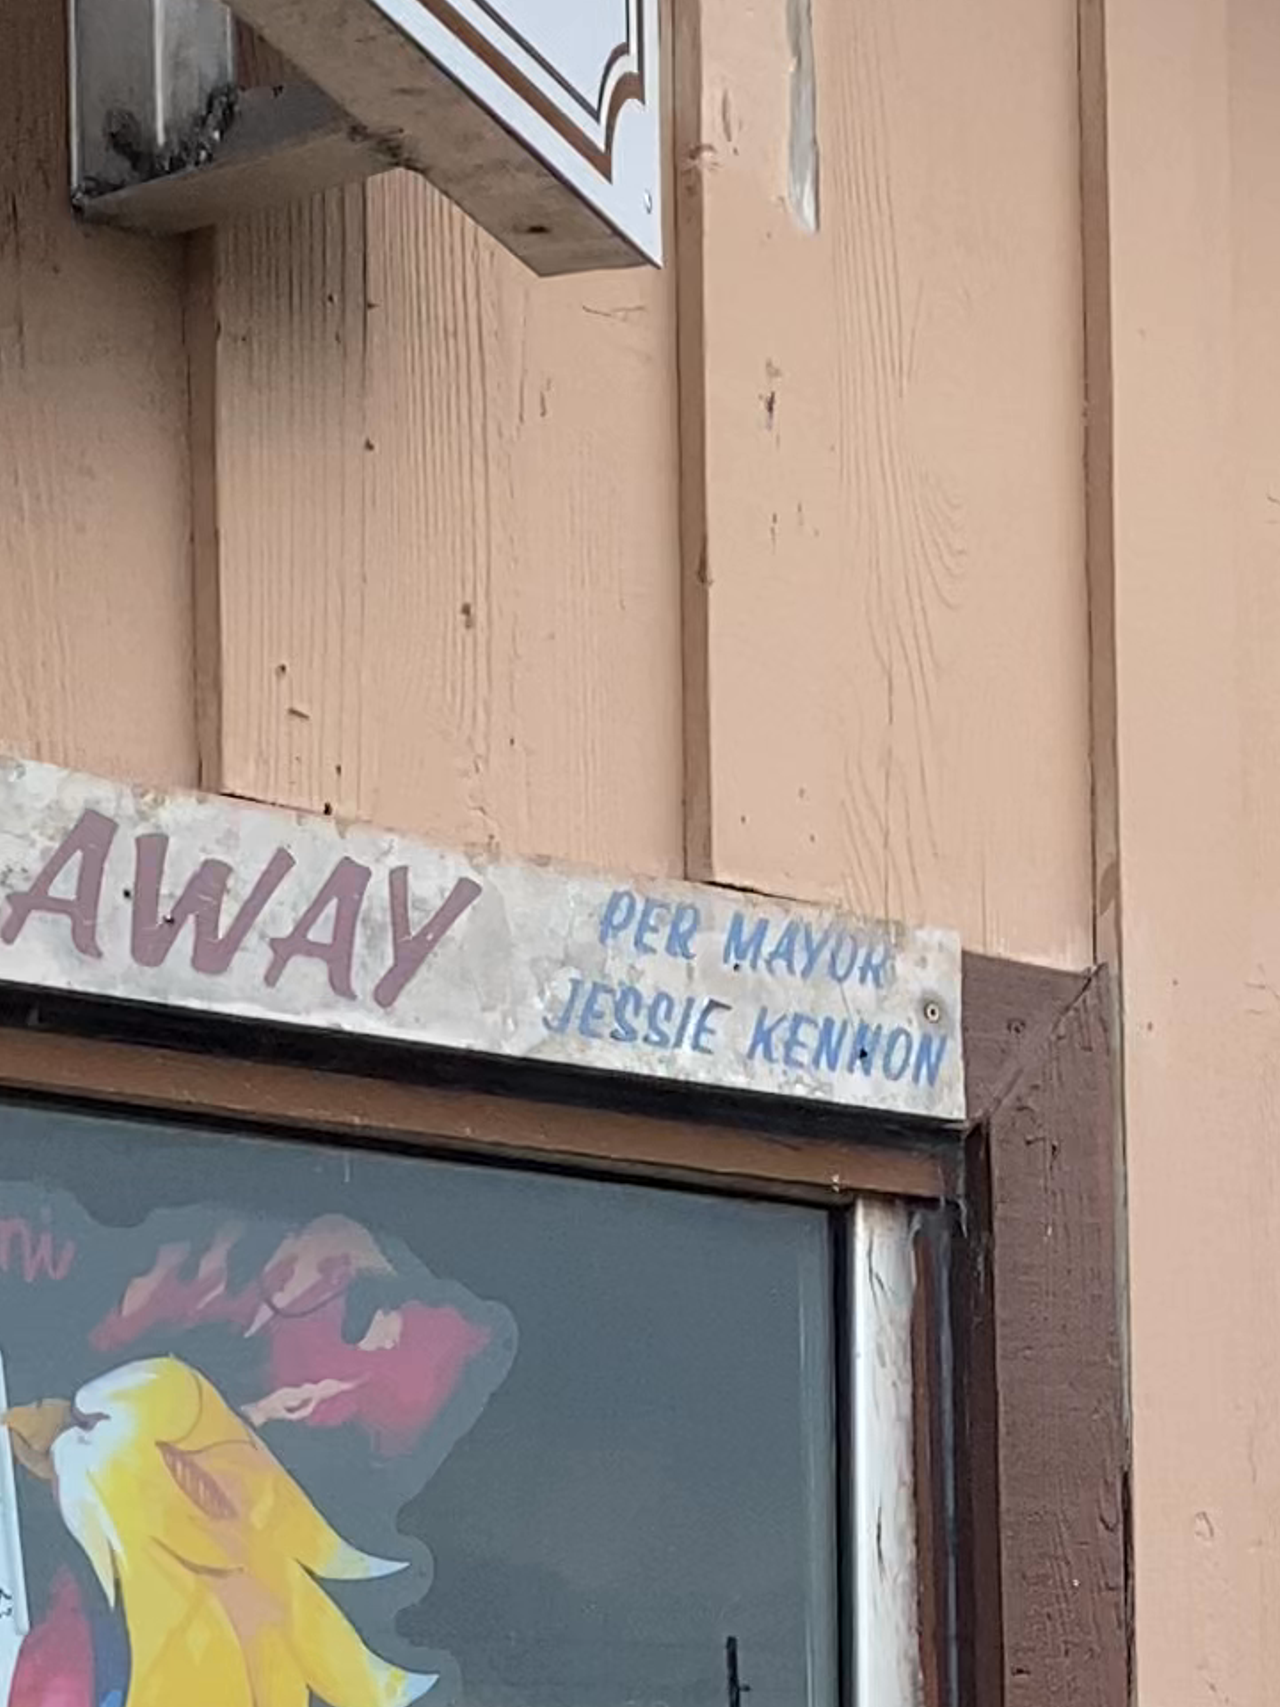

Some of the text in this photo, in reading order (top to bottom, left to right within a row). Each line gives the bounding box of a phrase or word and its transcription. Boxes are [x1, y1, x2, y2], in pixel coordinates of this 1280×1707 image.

[0, 808, 483, 1010] AWAY
[599, 889, 895, 989] PER MAYOR
[542, 977, 949, 1088] JESSIE KENNON
